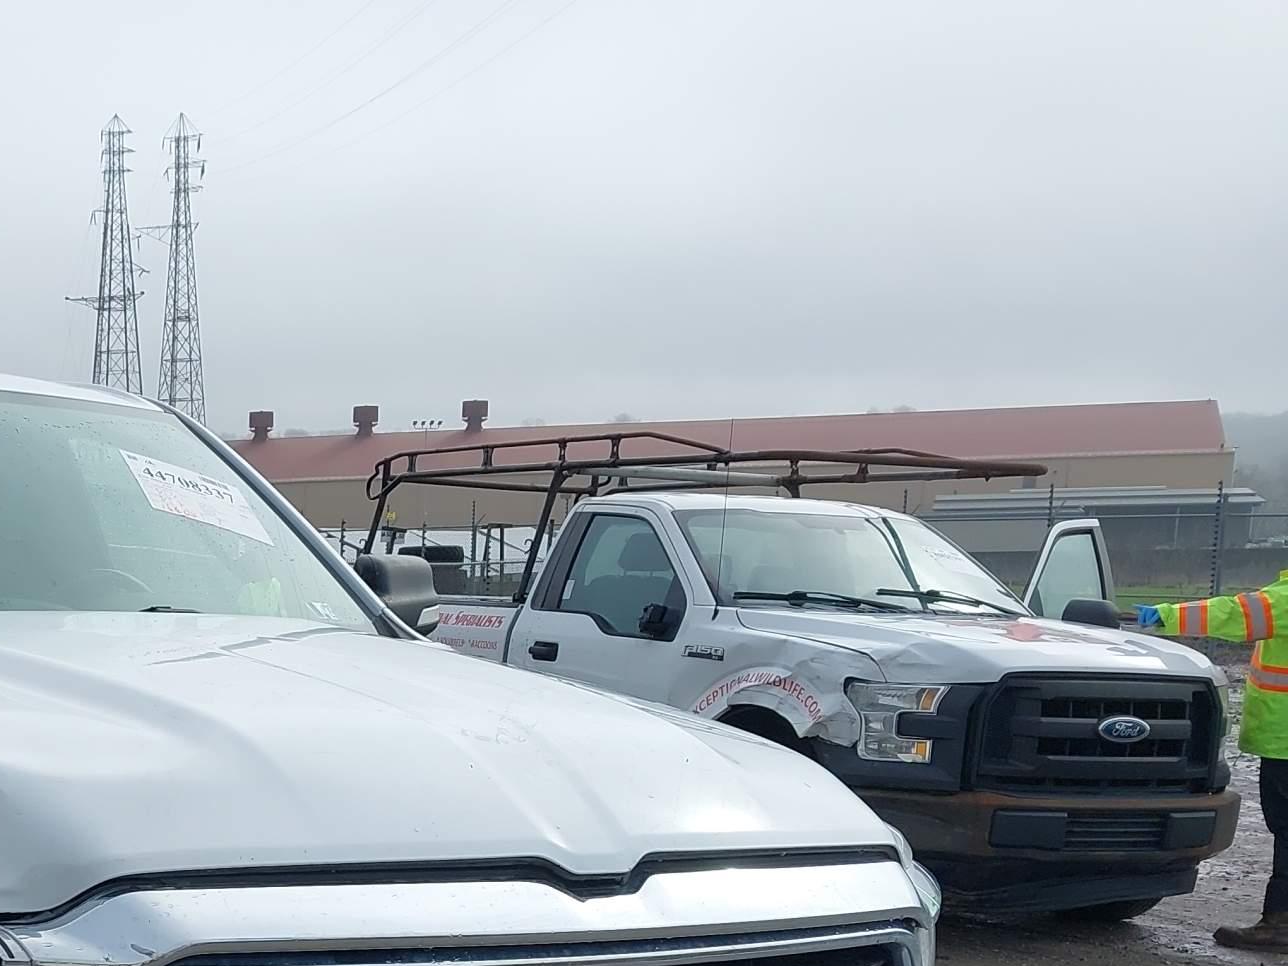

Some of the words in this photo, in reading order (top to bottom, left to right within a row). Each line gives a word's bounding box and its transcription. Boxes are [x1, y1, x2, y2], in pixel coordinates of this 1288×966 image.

[143, 467, 235, 504] 44708337
[692, 671, 824, 722] XCEPTIONALWILDLIFE.COM
[1112, 721, 1141, 737] Ford
